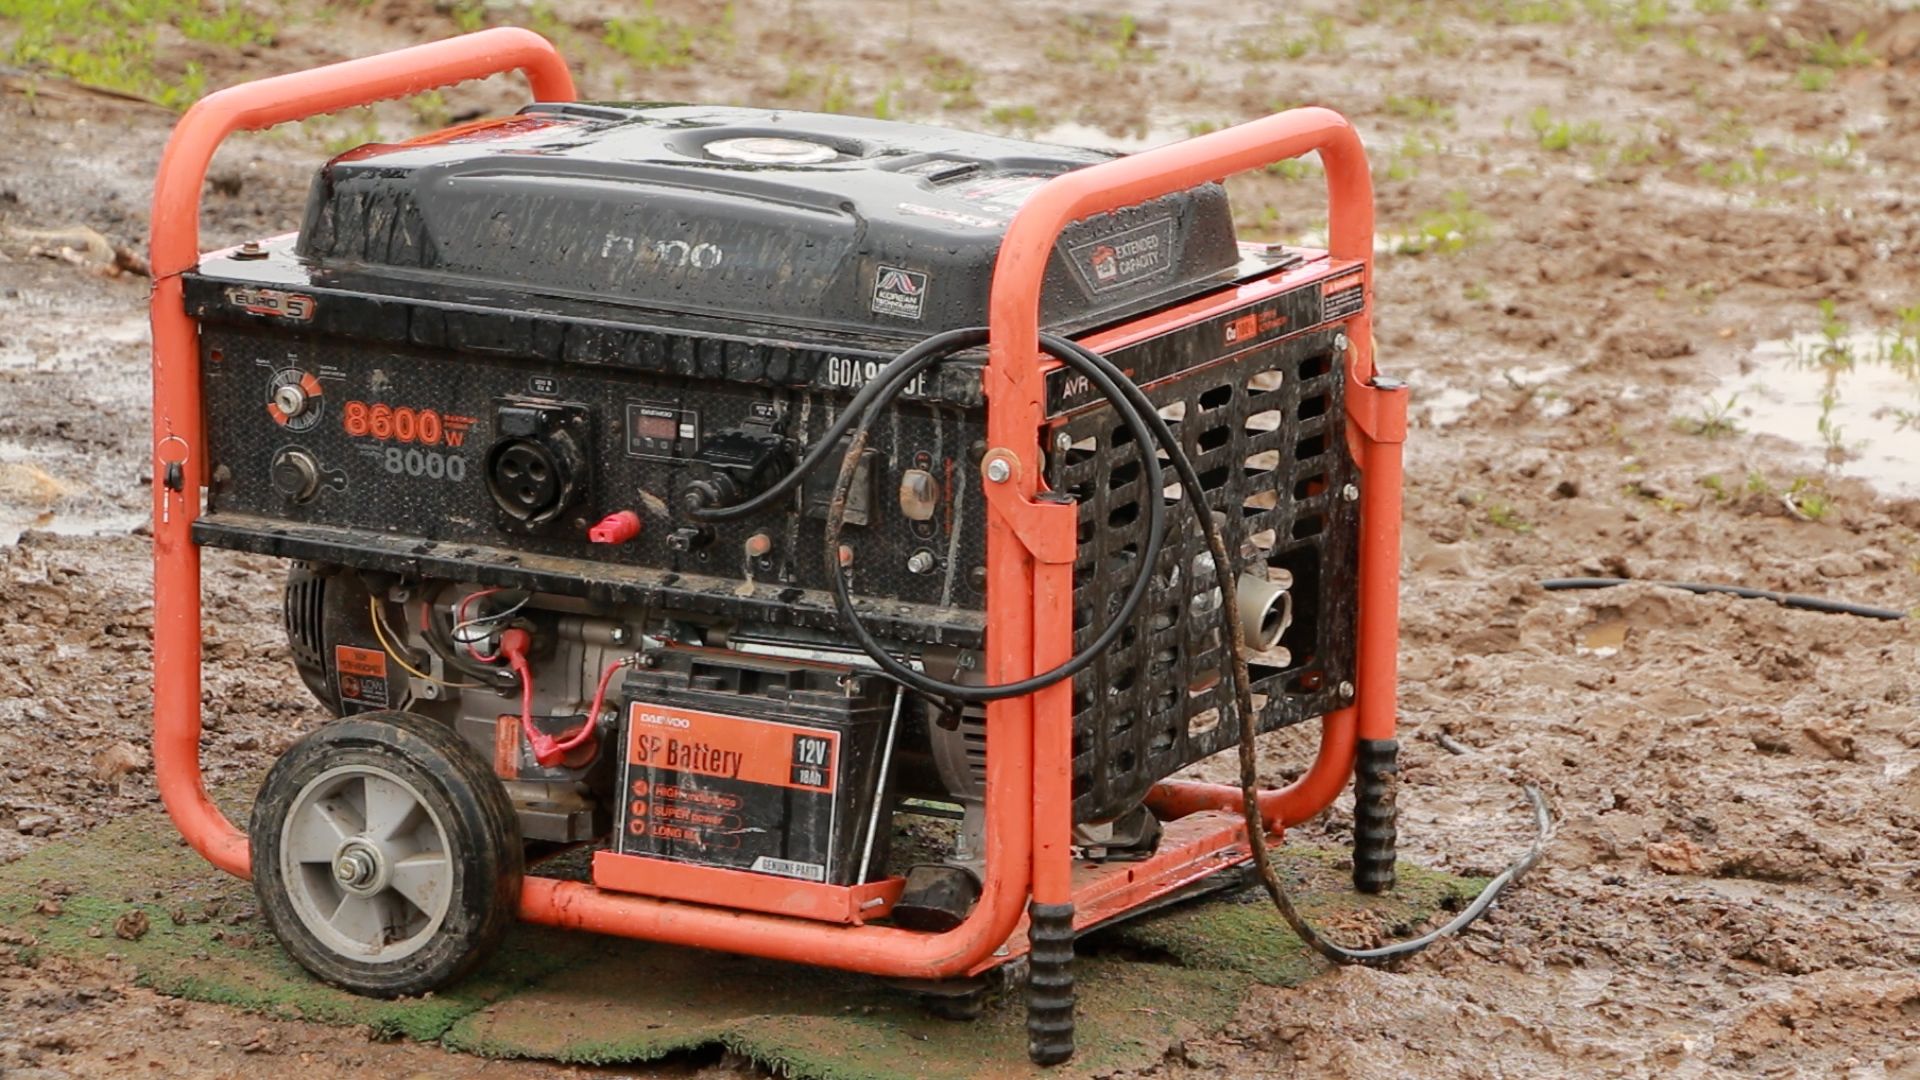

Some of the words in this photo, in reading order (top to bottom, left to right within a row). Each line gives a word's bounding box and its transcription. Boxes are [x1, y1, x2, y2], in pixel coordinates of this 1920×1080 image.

[1115, 235, 1159, 259] EXTENDED
[1119, 251, 1159, 275] CAPACITY
[235, 294, 279, 309] EURO
[287, 301, 304, 317] 5
[1062, 375, 1089, 400] AVR
[343, 400, 442, 446] 8600
[444, 430, 464, 447] W
[384, 446, 466, 482] 8000
[640, 713, 690, 729] DAEWOO
[667, 738, 743, 780] Battery
[799, 738, 826, 765] 12V
[655, 786, 683, 800] HIGH
[654, 805, 691, 820] SUPER
[653, 825, 682, 840] LONG
